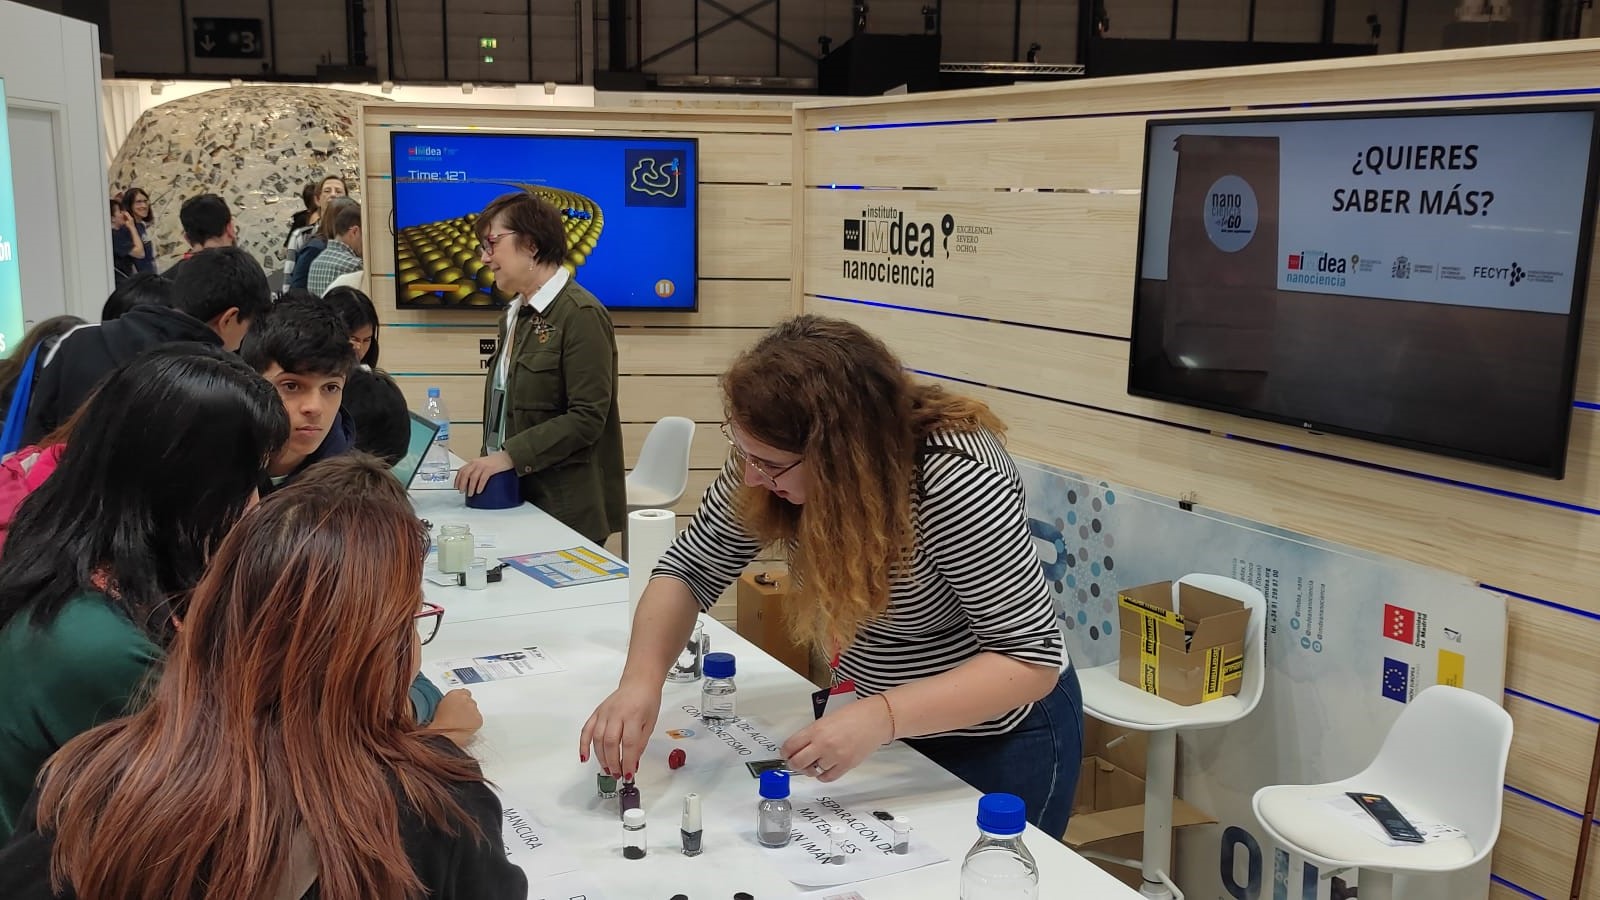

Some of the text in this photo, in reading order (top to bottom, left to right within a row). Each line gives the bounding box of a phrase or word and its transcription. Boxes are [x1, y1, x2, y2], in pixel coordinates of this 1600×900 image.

[241, 31, 255, 53] 3
[1352, 144, 1479, 175] ¿QUIERES
[408, 169, 466, 181] Time: 127
[1212, 193, 1242, 208] nano
[1332, 183, 1494, 216] SABER MÁS?
[867, 205, 898, 219] instituto
[956, 225, 993, 236] EXCELENCIA
[956, 235, 979, 244] SEVERO
[956, 244, 977, 254] OCHOA
[1300, 251, 1347, 274] idea
[843, 257, 934, 288] nanociencia
[1286, 272, 1346, 287] nanociencia
[1473, 266, 1510, 280] FECYT
[503, 807, 544, 850] MANICURA
[816, 796, 895, 856] SEPARACIÓN DE
